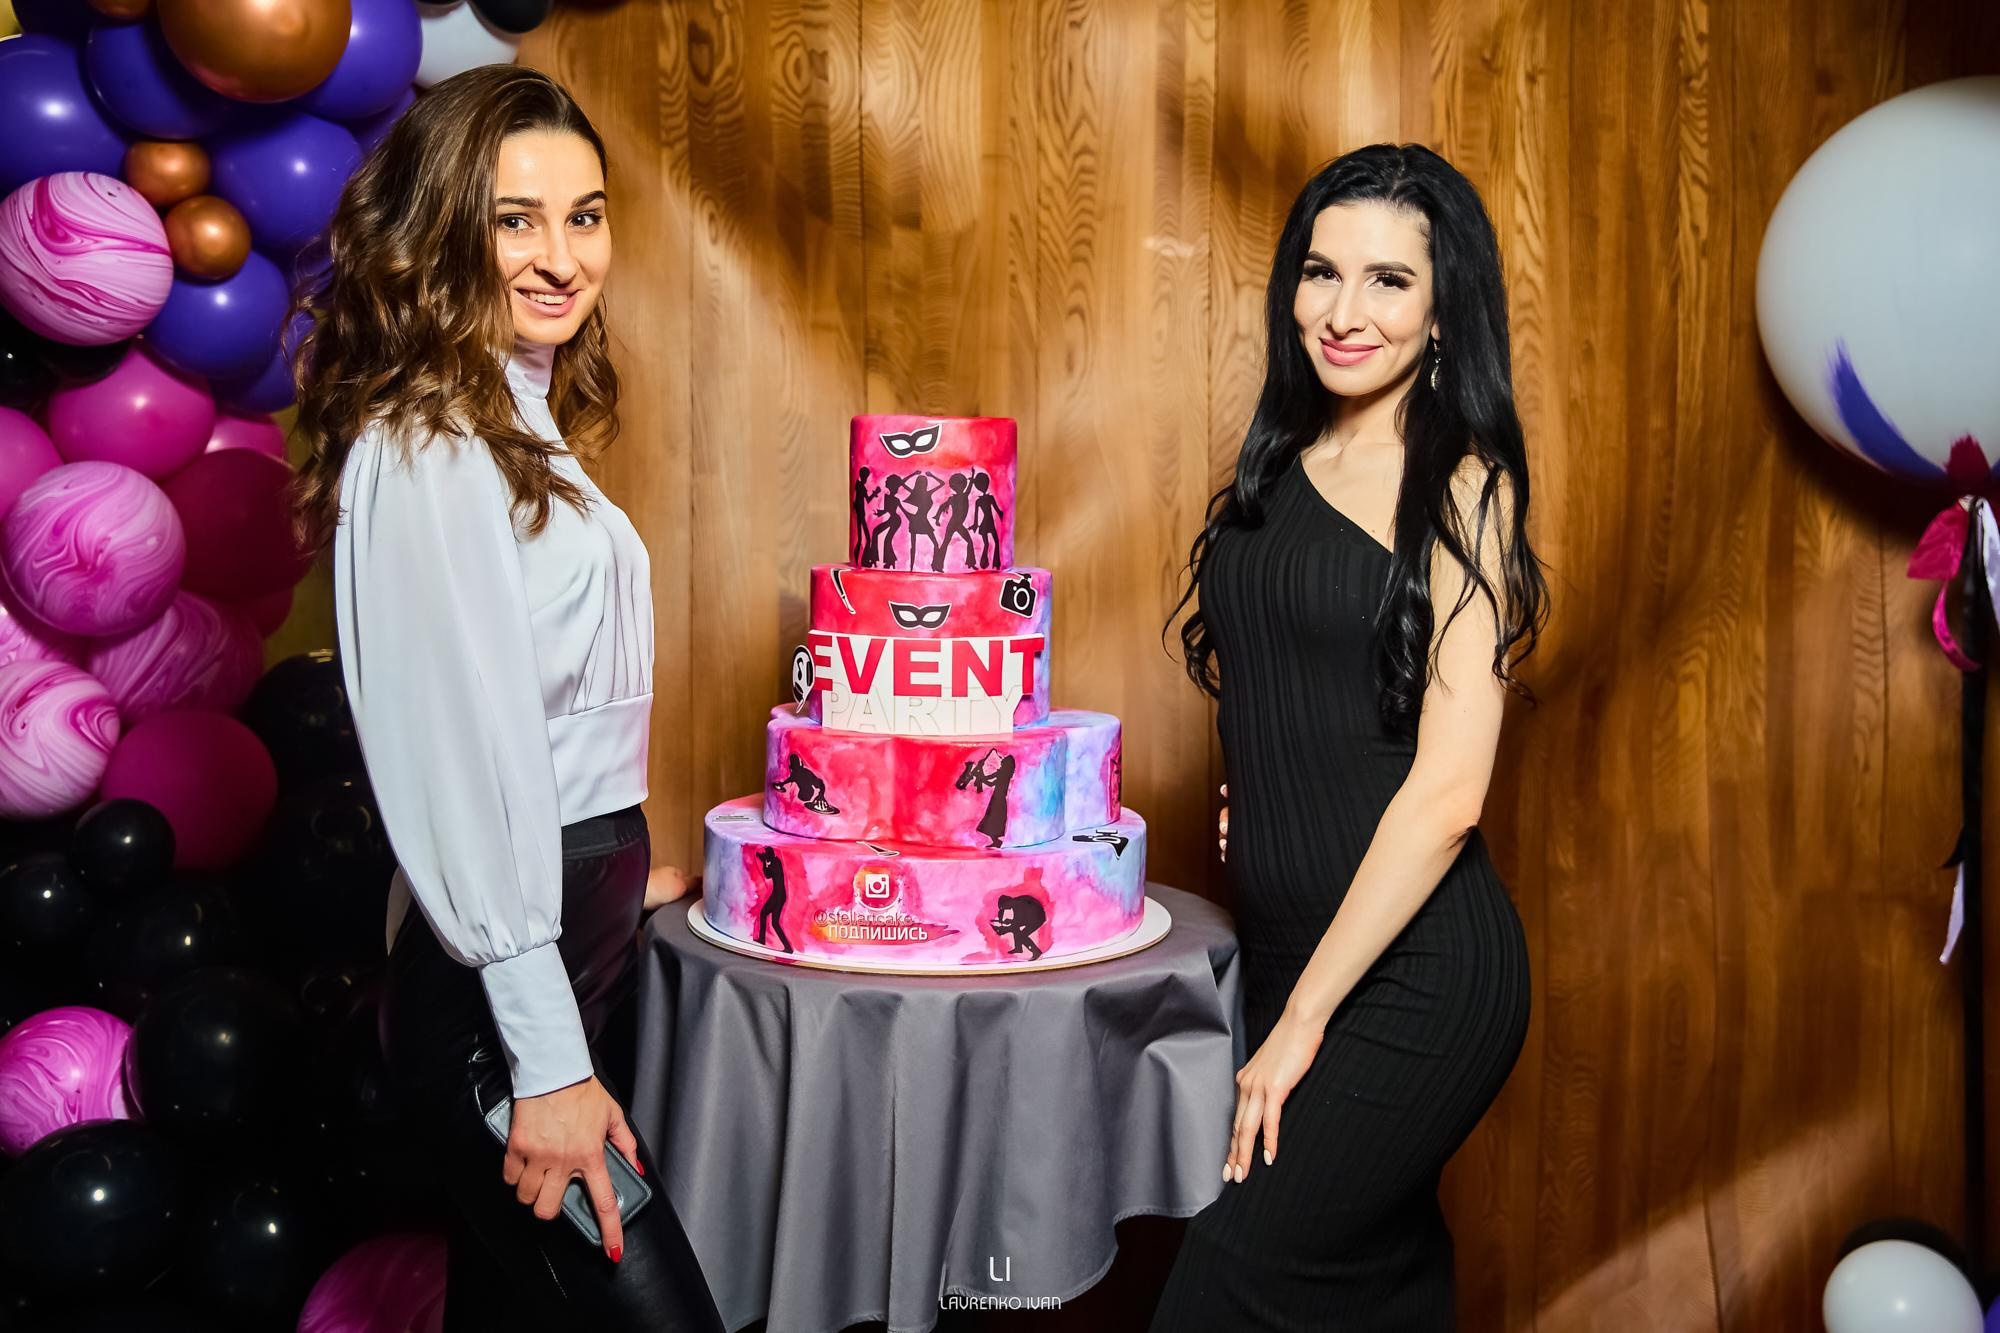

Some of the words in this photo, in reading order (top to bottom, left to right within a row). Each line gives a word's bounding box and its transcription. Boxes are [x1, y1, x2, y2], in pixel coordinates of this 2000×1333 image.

[808, 634, 1045, 698] EVENT
[822, 682, 1022, 735] PARTY
[828, 925, 928, 940] ПОДПИШИСЬ
